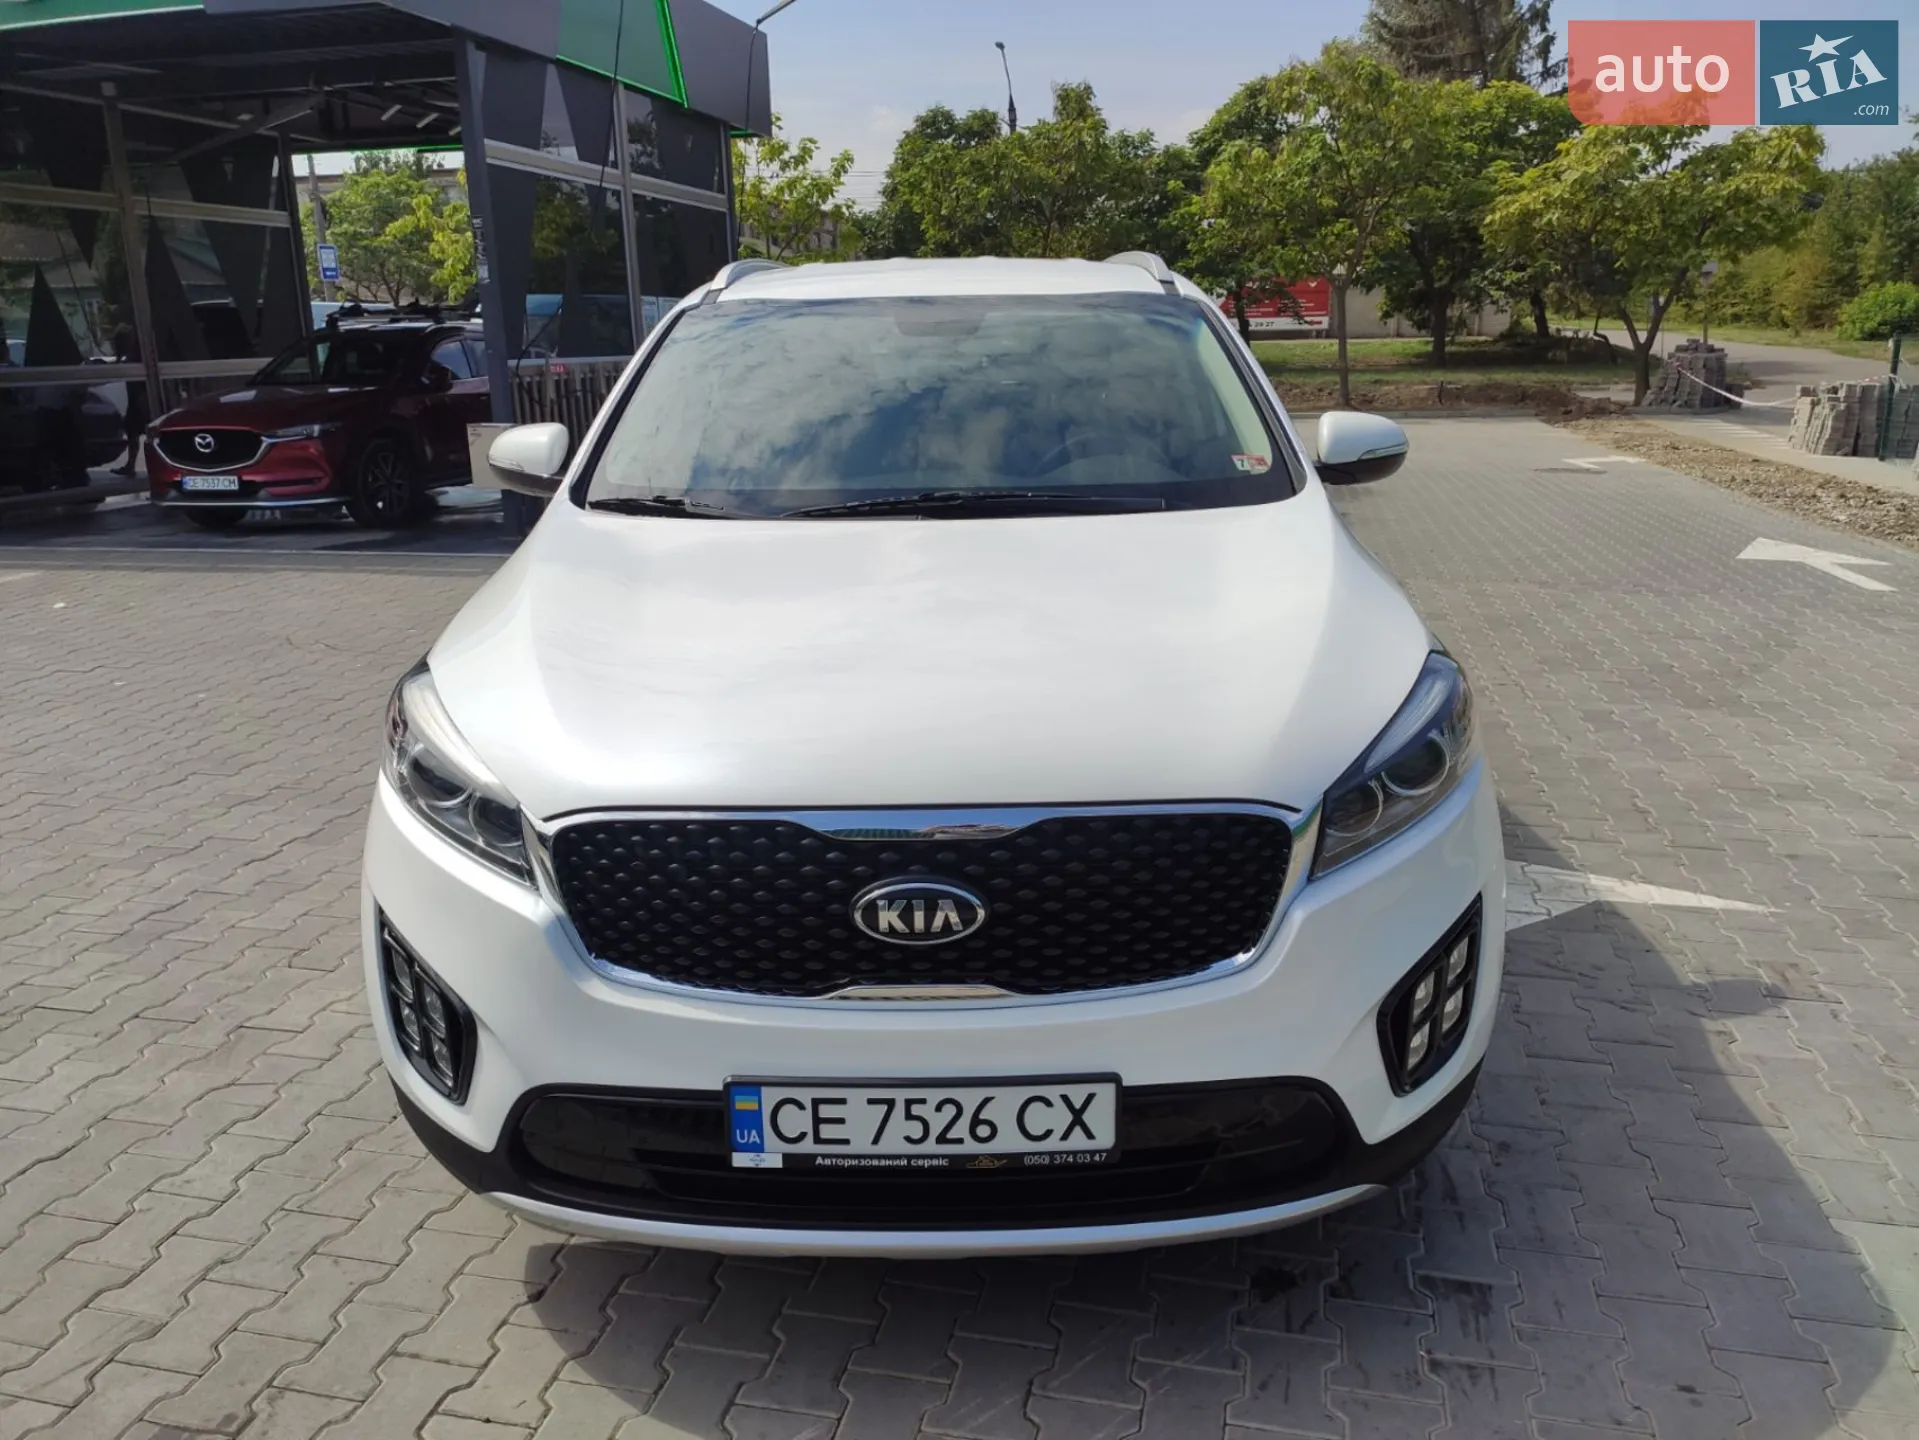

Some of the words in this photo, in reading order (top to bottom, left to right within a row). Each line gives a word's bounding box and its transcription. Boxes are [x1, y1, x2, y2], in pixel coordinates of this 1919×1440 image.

[876, 899, 964, 933] KIA
[769, 1097, 852, 1145] CE
[866, 1096, 999, 1145] 7526
[1015, 1092, 1097, 1142] CX
[736, 1129, 761, 1144] UA
[815, 1156, 908, 1167] Авторизований
[910, 1157, 949, 1167] сервіс
[1023, 1153, 1050, 1165] (050)
[1053, 1153, 1073, 1164] 374
[1076, 1153, 1090, 1163] 03
[1093, 1152, 1107, 1162] 47
